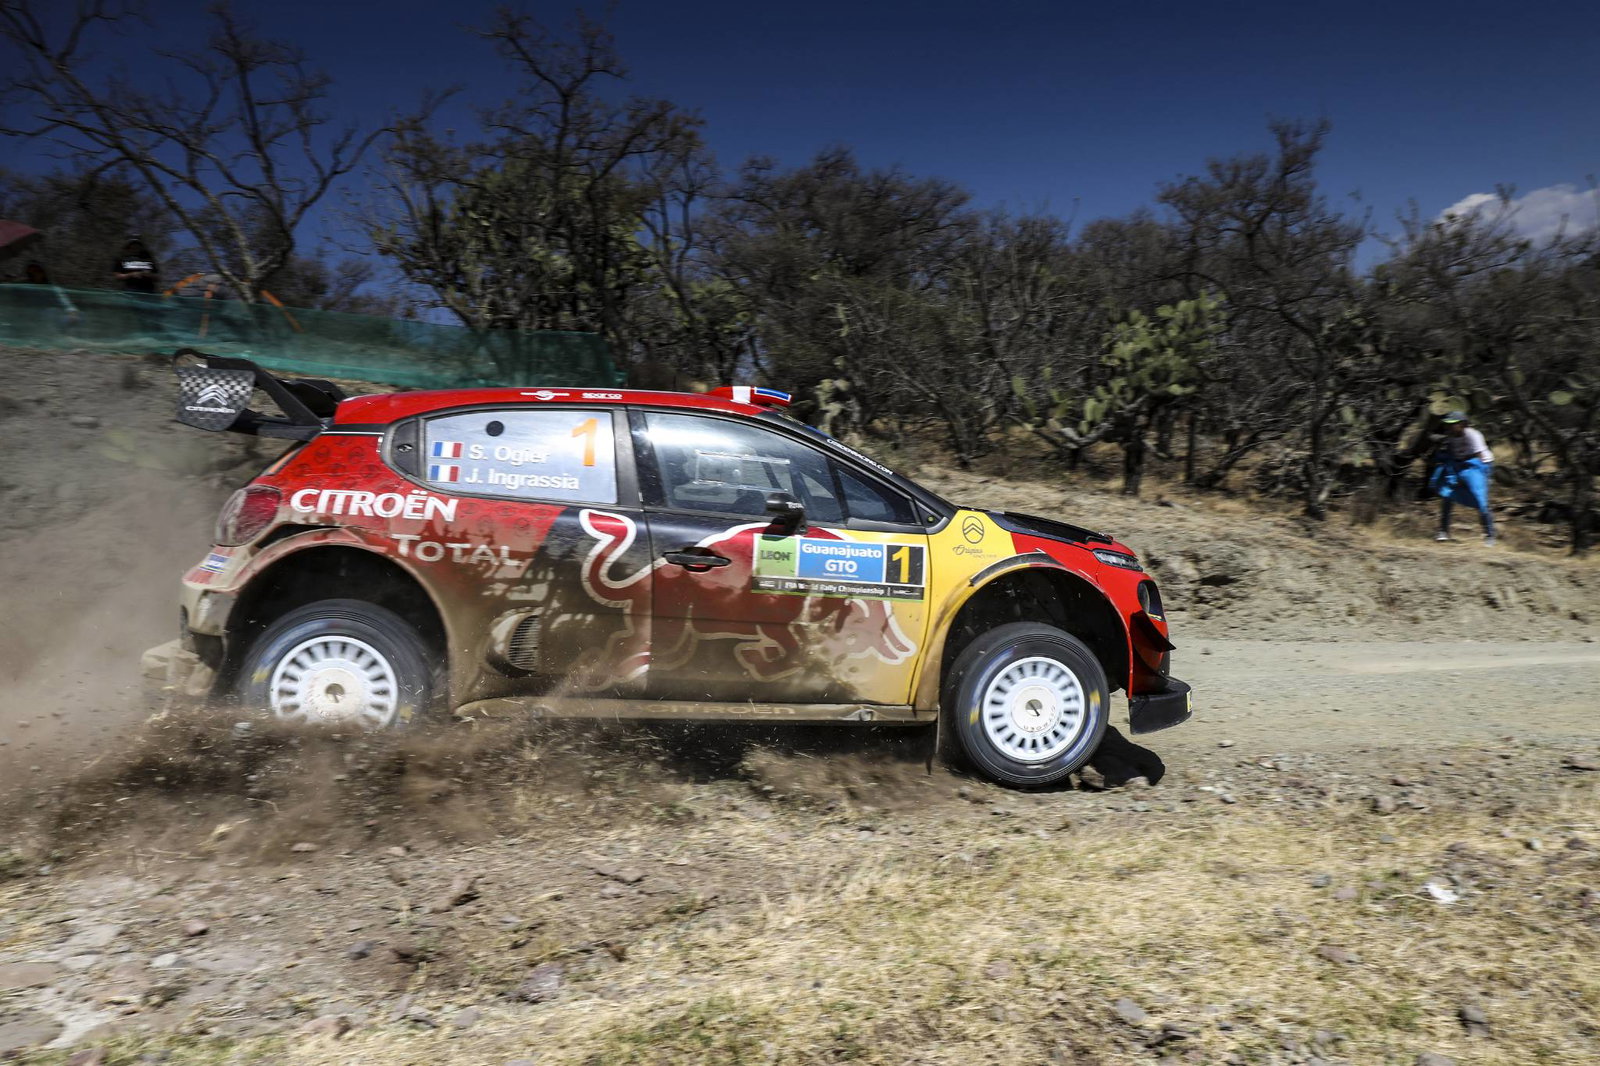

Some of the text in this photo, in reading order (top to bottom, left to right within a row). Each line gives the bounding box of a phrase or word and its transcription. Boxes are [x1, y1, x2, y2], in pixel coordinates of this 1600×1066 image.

[468, 443, 550, 466] S. Ogier
[571, 417, 600, 467] 1
[465, 468, 580, 490] J. Ingrassia
[289, 488, 459, 522] CITROËN
[391, 533, 524, 567] TOTAL
[801, 543, 883, 559] Guanajuato
[824, 558, 858, 574] GTO
[891, 546, 911, 584] 1
